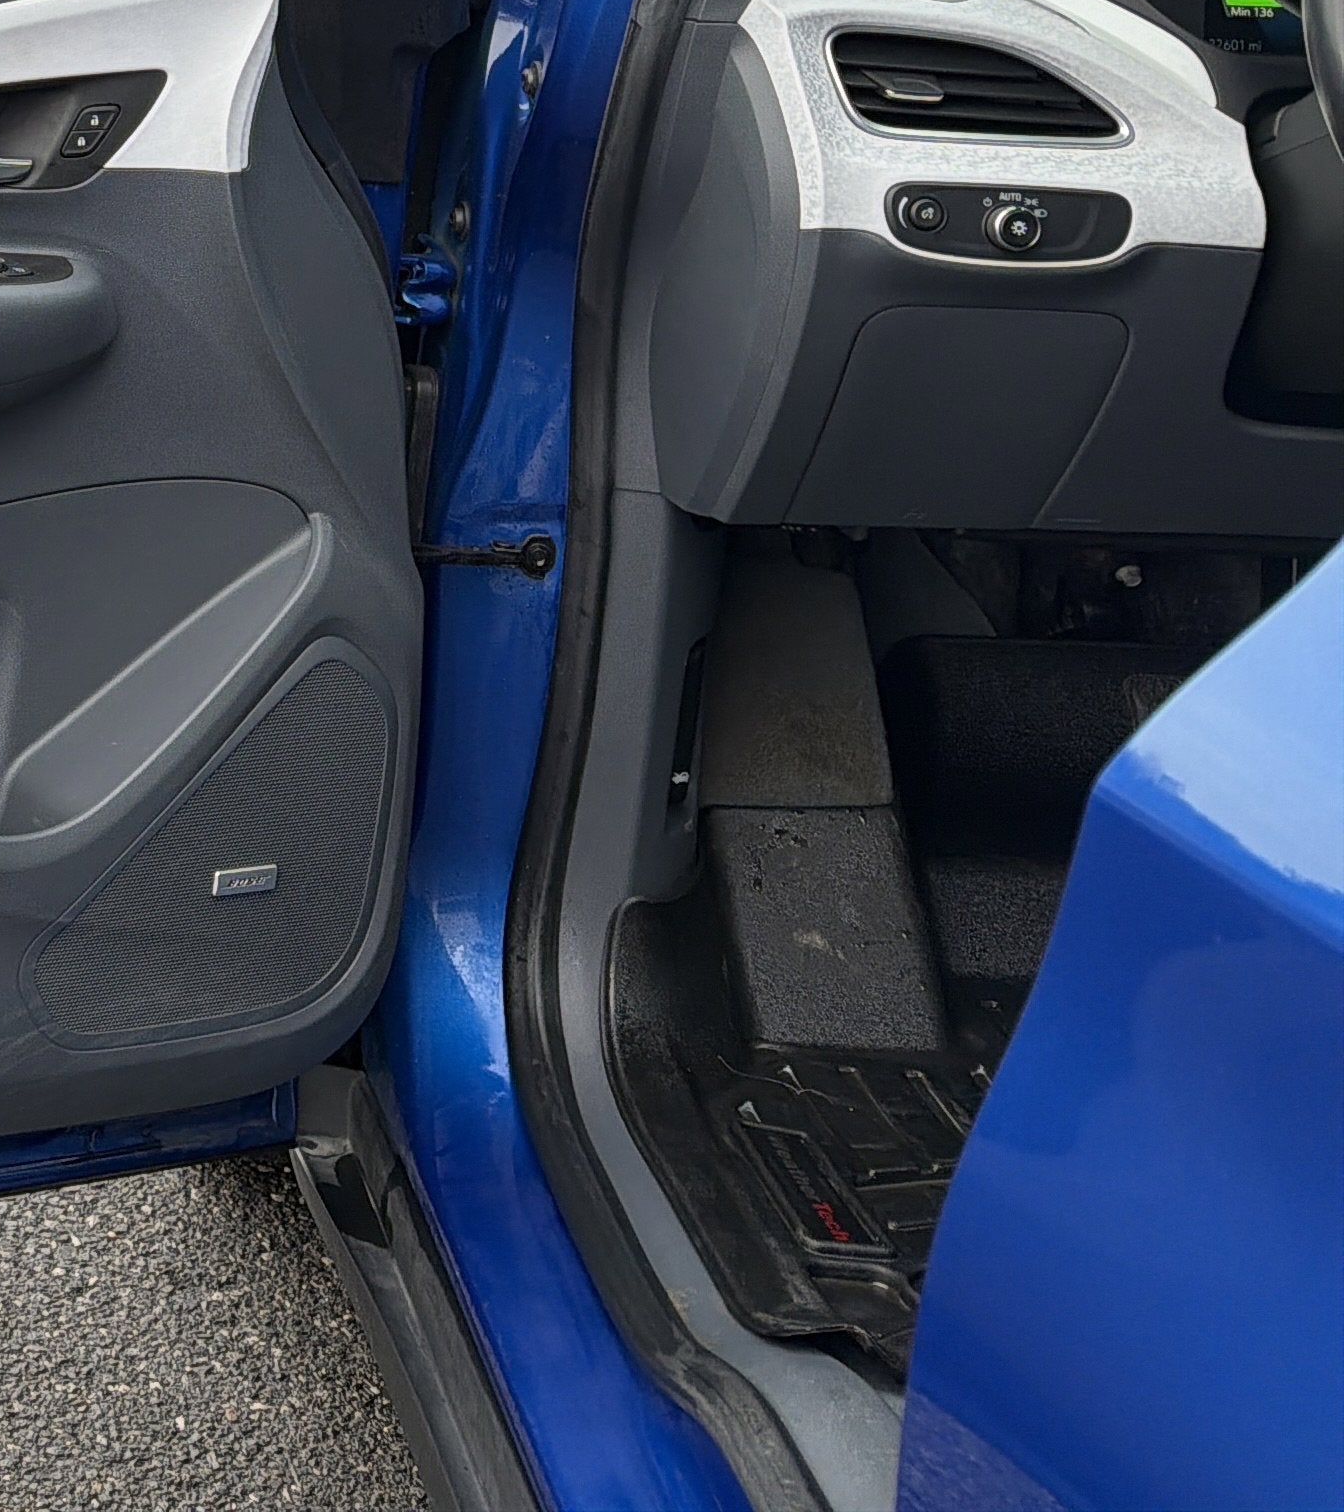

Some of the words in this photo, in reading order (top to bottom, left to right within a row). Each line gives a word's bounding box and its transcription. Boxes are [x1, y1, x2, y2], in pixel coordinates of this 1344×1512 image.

[1230, 7, 1251, 18] Min
[1253, 7, 1275, 18] 136
[1248, 40, 1263, 53] mi
[998, 191, 1022, 202] AUTO
